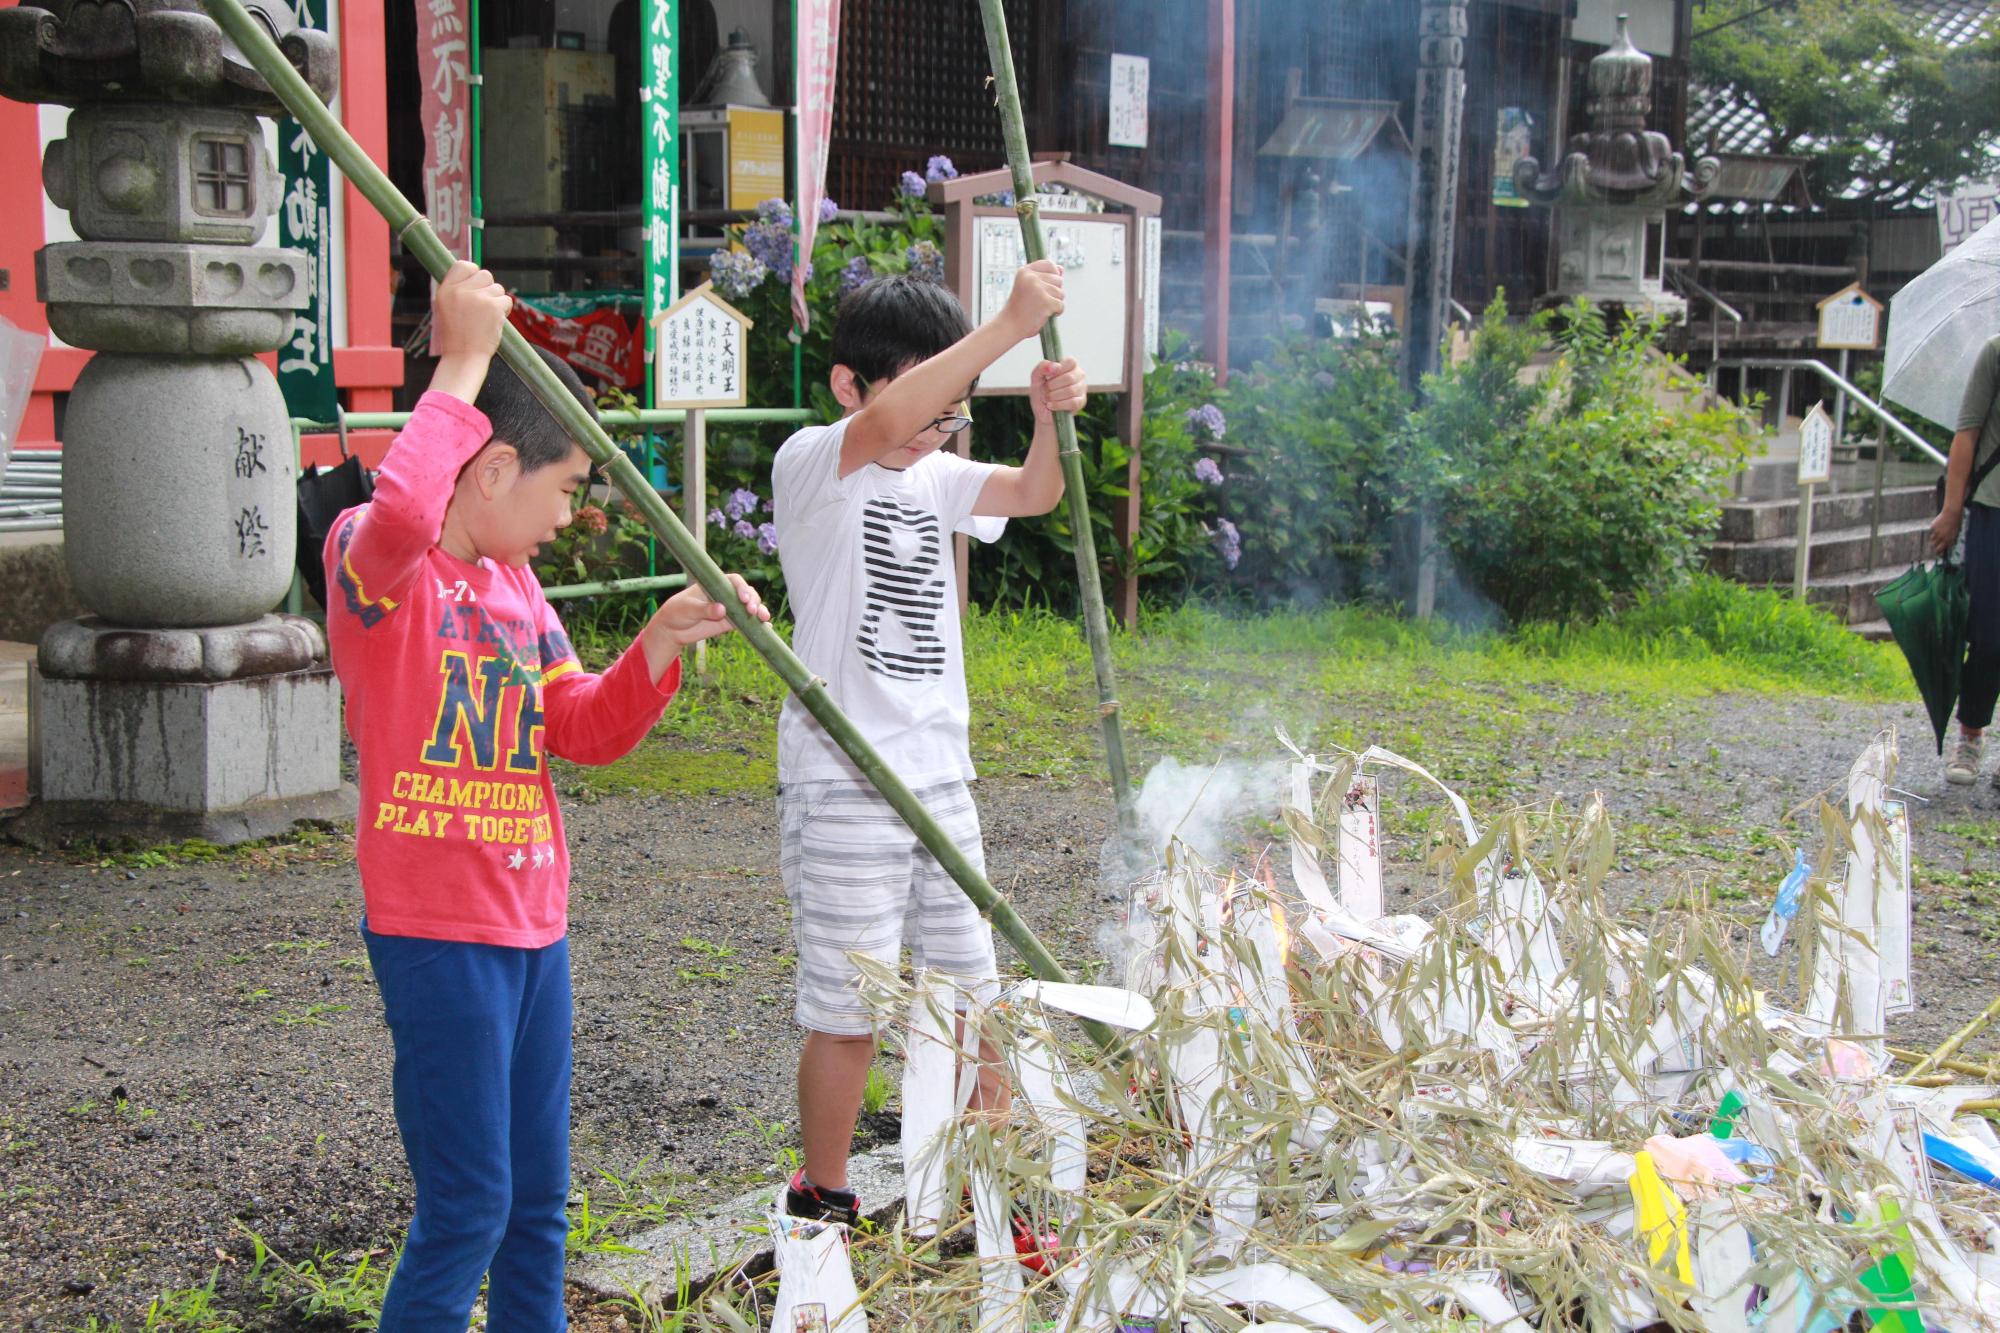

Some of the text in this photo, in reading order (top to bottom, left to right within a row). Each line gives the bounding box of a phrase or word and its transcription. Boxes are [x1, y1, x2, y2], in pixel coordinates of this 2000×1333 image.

[707, 317, 717, 385] 家内安全
[722, 321, 736, 393] 五大明王
[374, 802, 453, 838] PLAY
